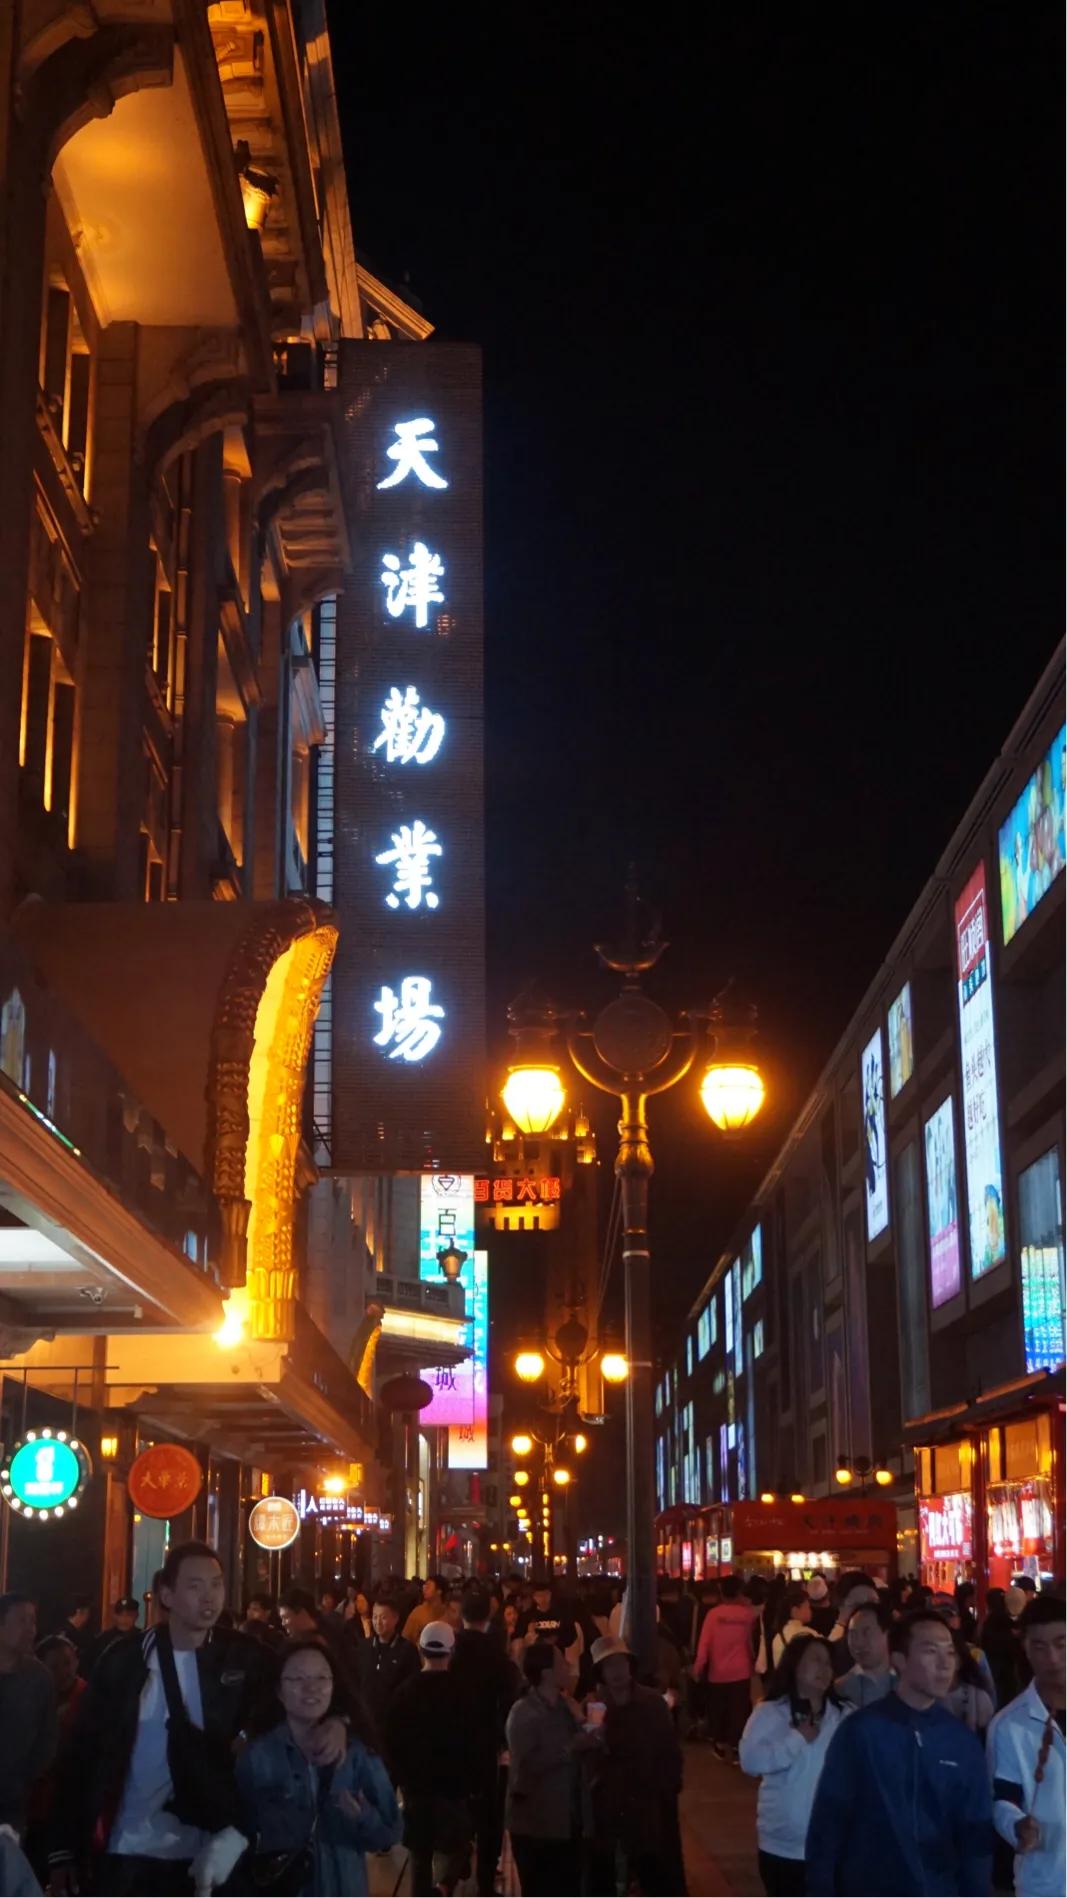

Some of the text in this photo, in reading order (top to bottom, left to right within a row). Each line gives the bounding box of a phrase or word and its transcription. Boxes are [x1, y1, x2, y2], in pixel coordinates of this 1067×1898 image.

[371, 417, 449, 1061] 天津勸業場
